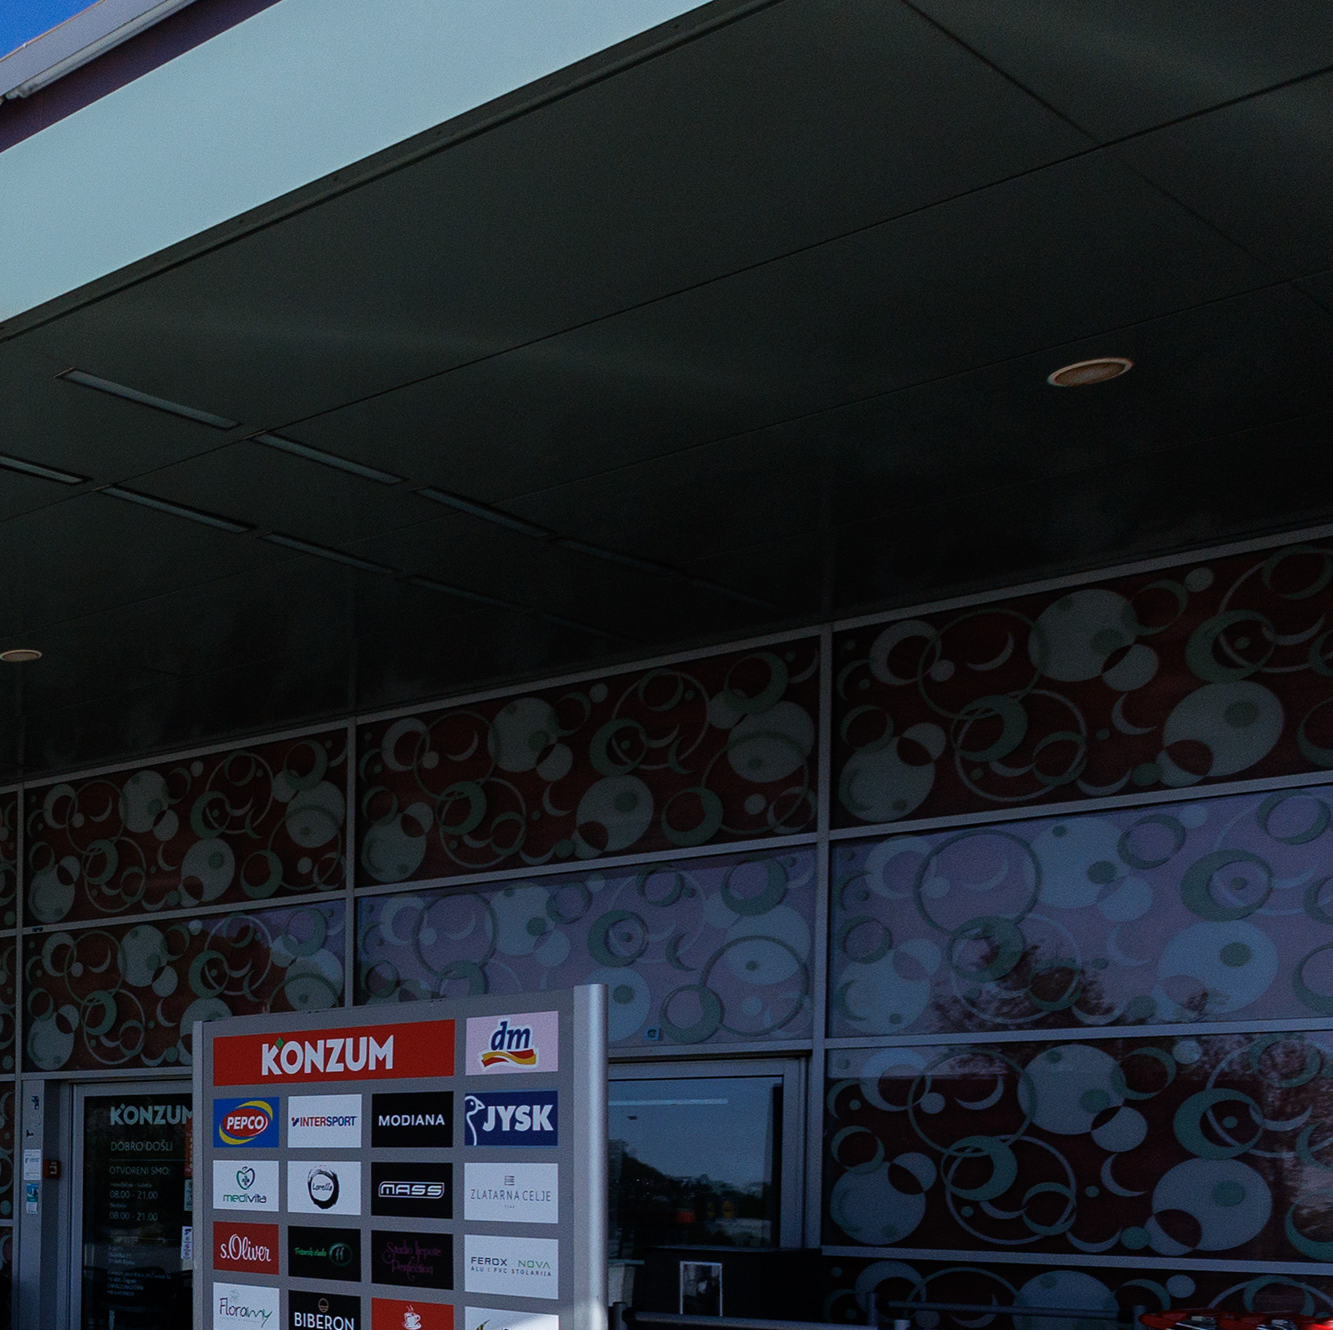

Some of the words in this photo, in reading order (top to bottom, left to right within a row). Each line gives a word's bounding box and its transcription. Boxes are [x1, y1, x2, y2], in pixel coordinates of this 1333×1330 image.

[491, 1021, 531, 1051] dm
[261, 1034, 394, 1076] KONZUM
[226, 1115, 264, 1131] PEPCO
[300, 1116, 357, 1127] INTERSPORT
[378, 1114, 446, 1126] MODIANA
[482, 1104, 554, 1132] JYSK
[110, 1141, 143, 1152] DOBRO
[145, 1139, 173, 1152] DOŠLI
[109, 1165, 149, 1176] OTVORENI
[109, 1190, 131, 1200] 08.00
[137, 1190, 158, 1200] 21.00
[222, 1193, 267, 1203] medivita
[470, 1189, 520, 1201] ZLATARNA
[522, 1190, 552, 1202] CELJE
[109, 1211, 131, 1221] 08.00
[136, 1212, 158, 1222] 21.00
[220, 1233, 272, 1262] s.Oliver
[470, 1256, 508, 1267] FEROX
[517, 1260, 551, 1269] NOVA
[511, 1268, 552, 1277] STOLARIJA
[219, 1297, 273, 1328] Floramy
